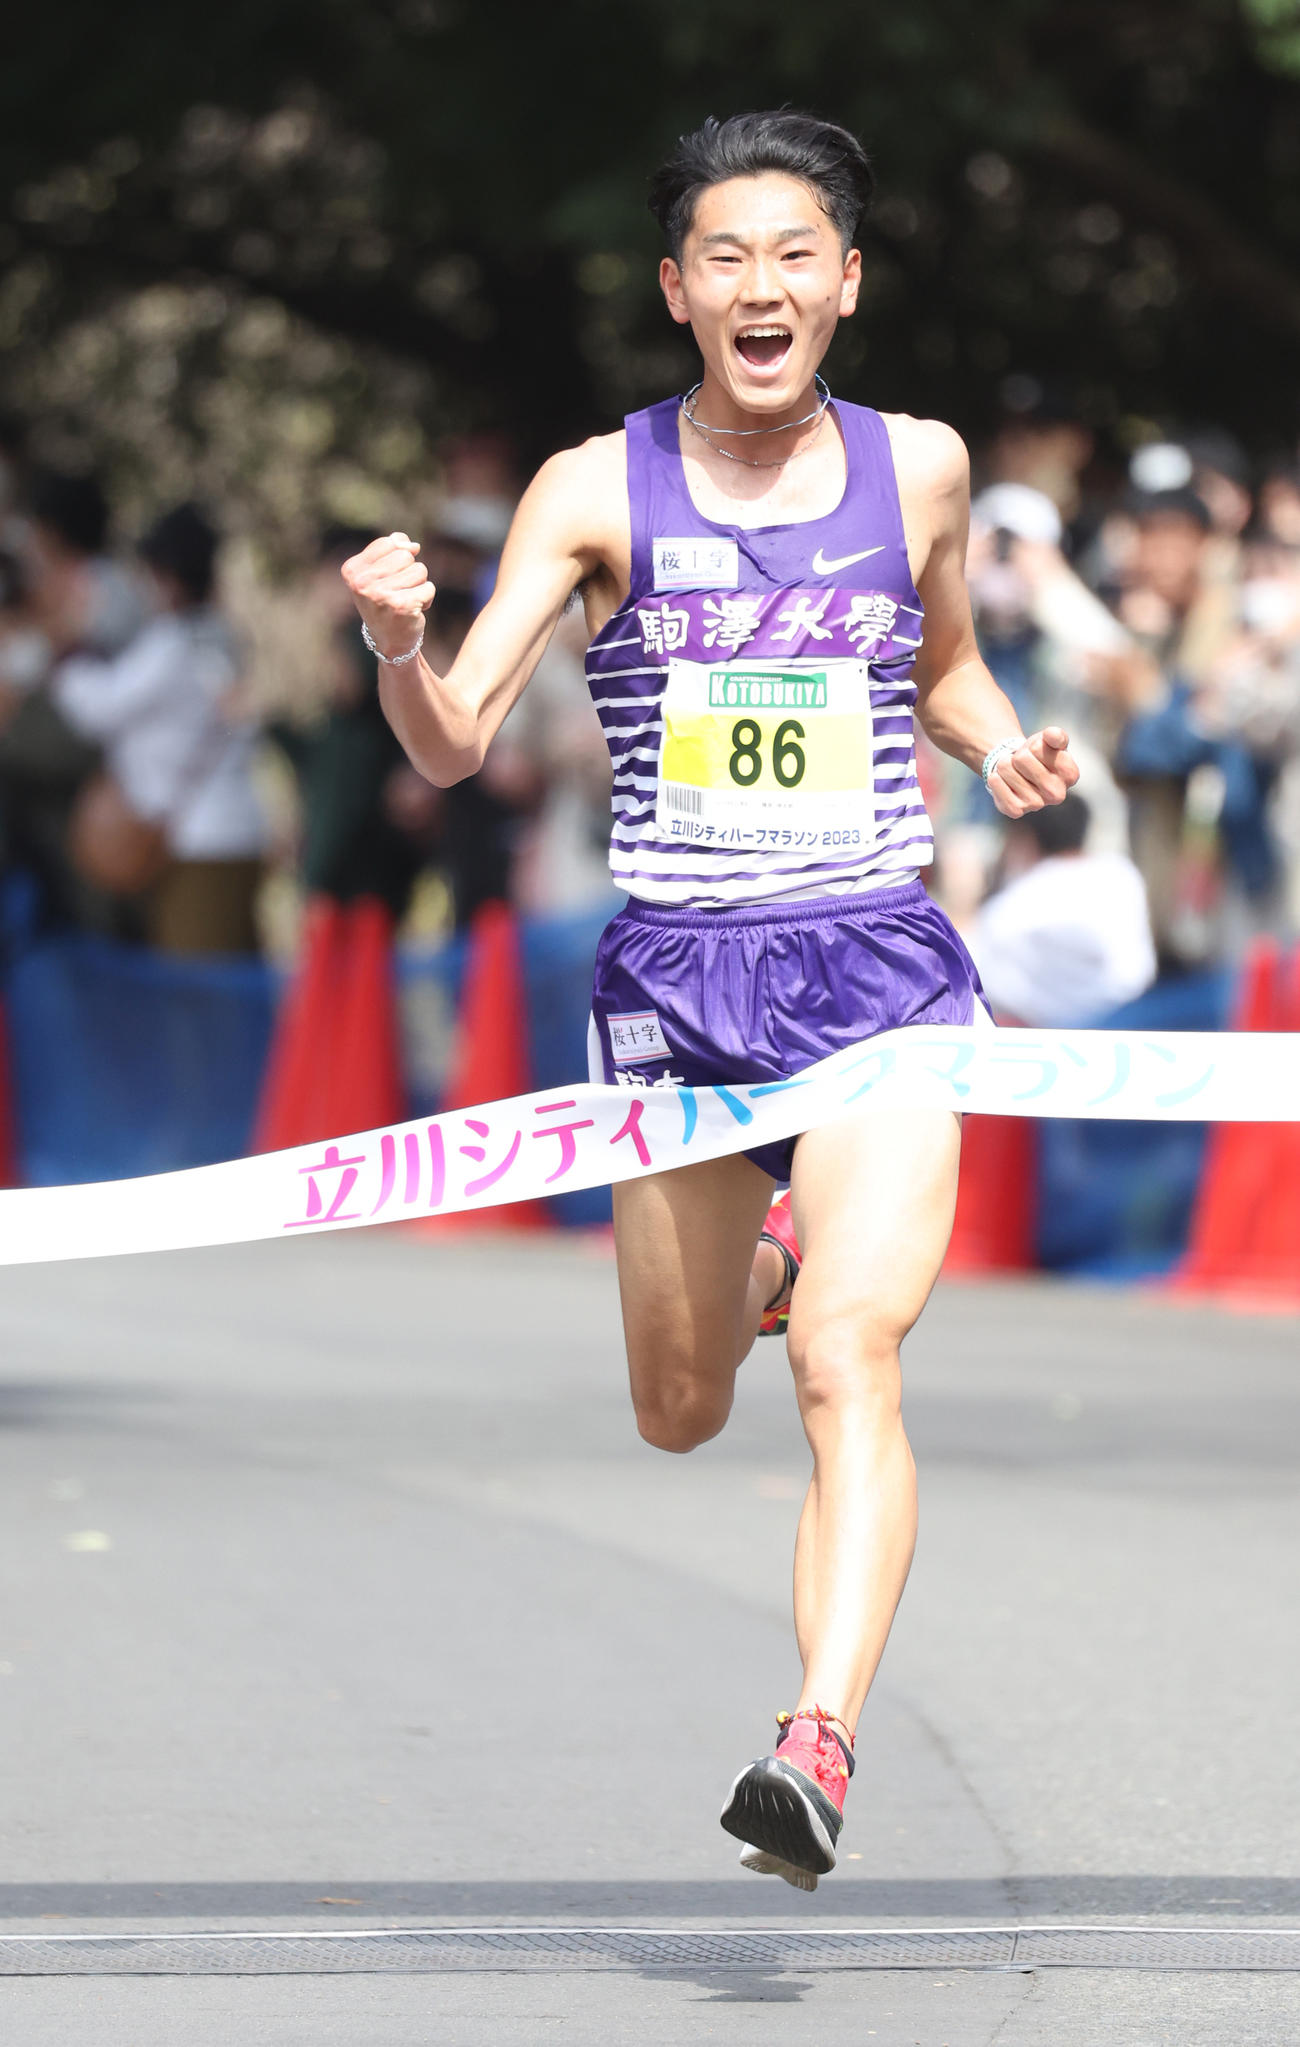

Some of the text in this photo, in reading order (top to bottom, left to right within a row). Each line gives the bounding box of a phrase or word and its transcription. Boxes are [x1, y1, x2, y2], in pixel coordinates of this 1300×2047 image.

[638, 594, 899, 655] 駒澤大學
[711, 674, 825, 705] KOTOBUKIYA
[729, 718, 806, 788] 86
[670, 819, 861, 846] 立川シティハーフマラソン 2023
[613, 1024, 658, 1047] 桜十字
[283, 1041, 1216, 1229] 立川シティハーフマラソン
